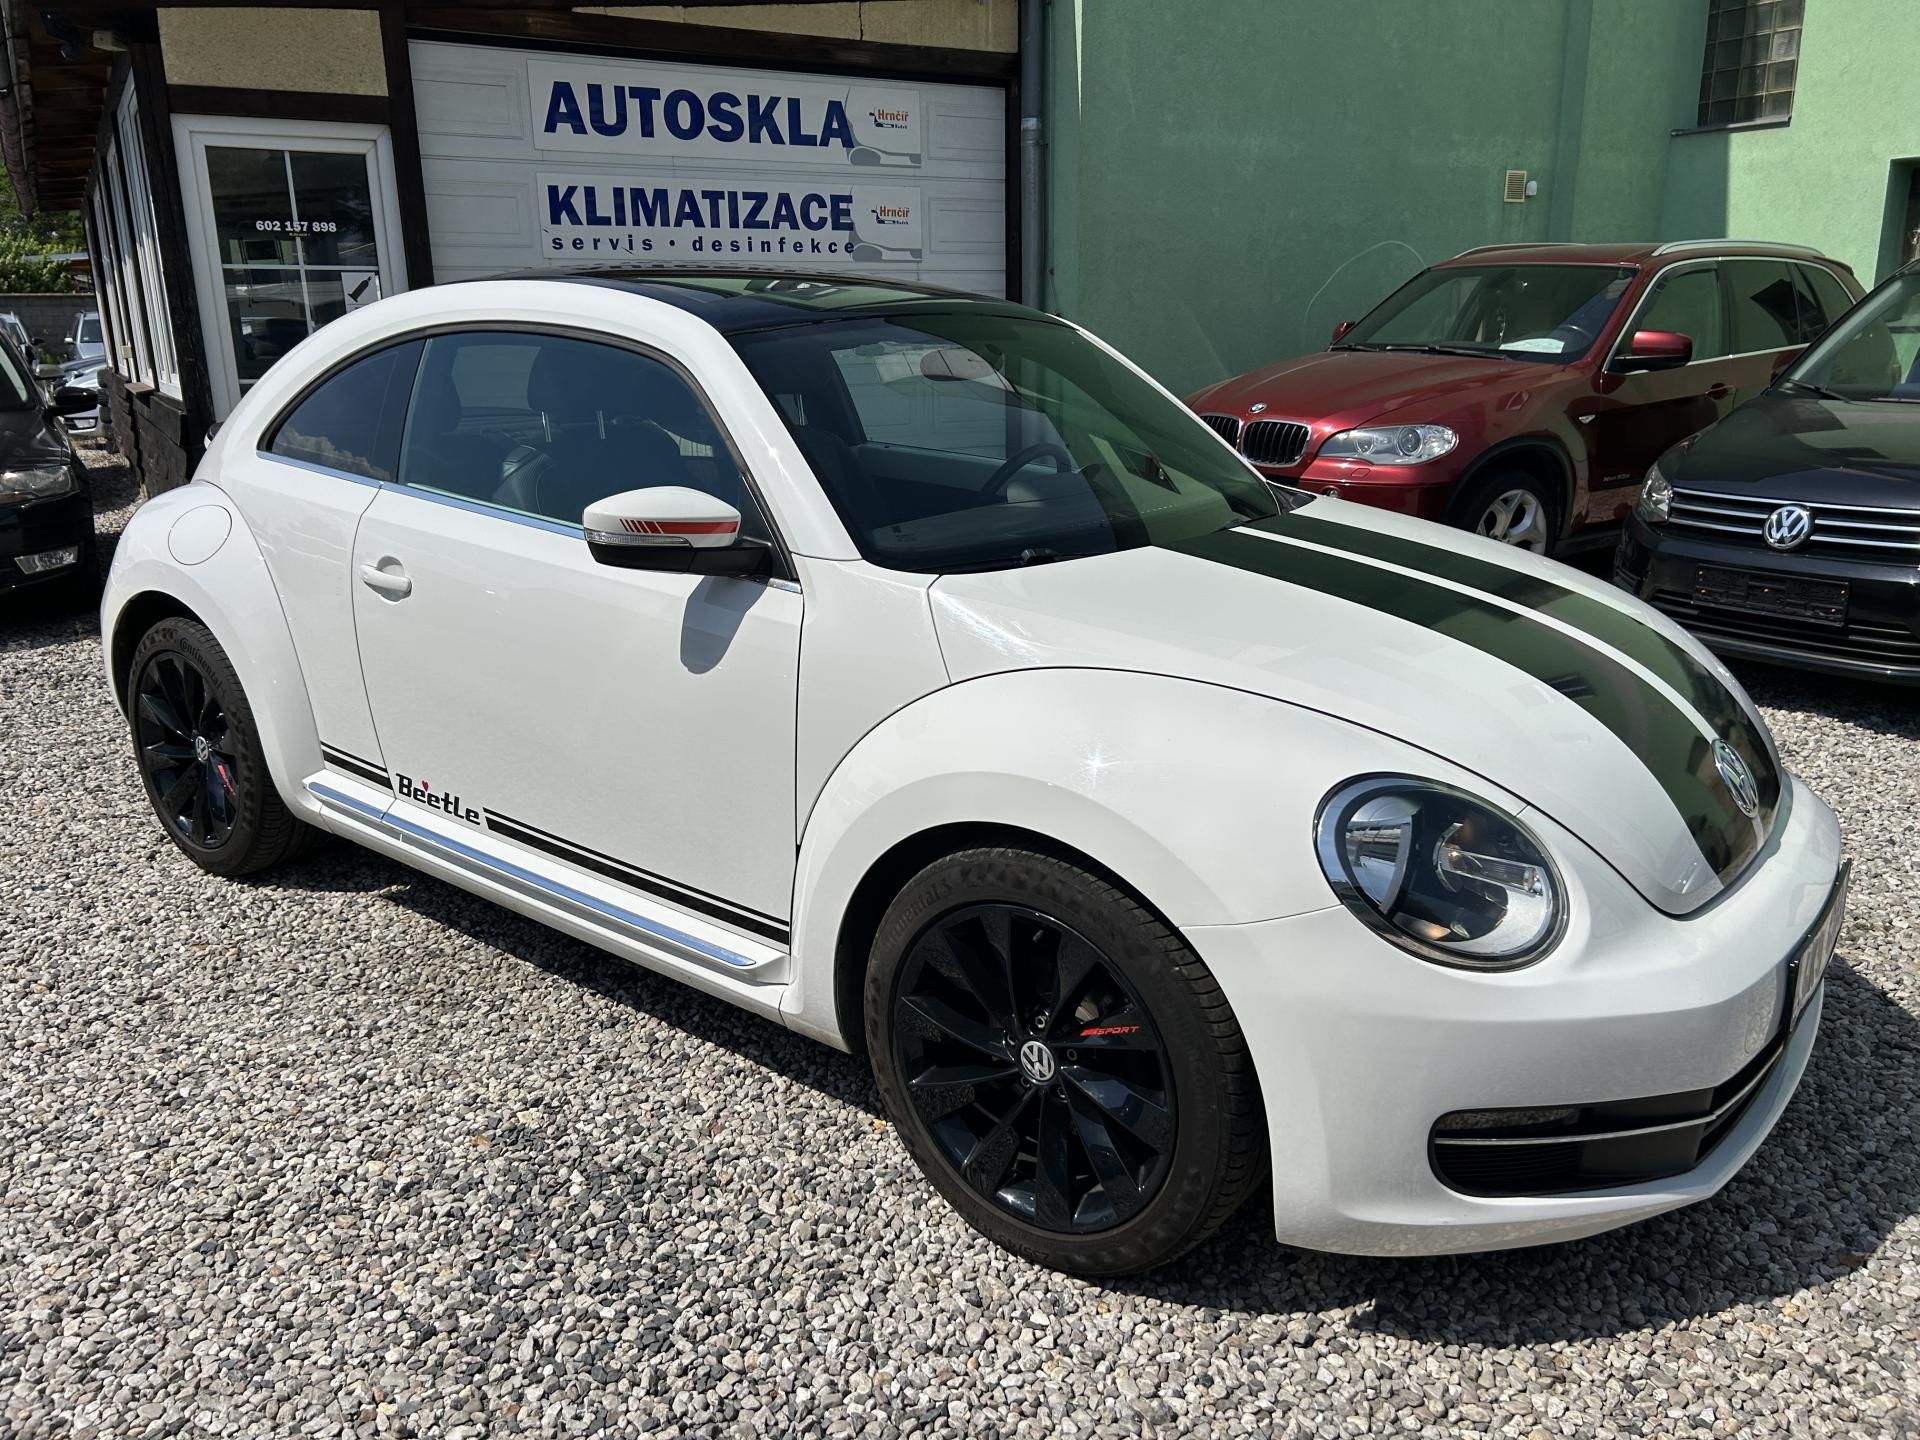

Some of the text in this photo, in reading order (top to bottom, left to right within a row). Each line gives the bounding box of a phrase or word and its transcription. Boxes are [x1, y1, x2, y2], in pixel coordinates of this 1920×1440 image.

[544, 81, 854, 148] AUTOSKLA
[547, 185, 854, 231] KLIMATIZACE
[255, 220, 337, 233] 602 157 898
[552, 234, 855, 254] servis desinfekce
[395, 772, 481, 826] Beetle
[1097, 1026, 1140, 1036] SPORT
